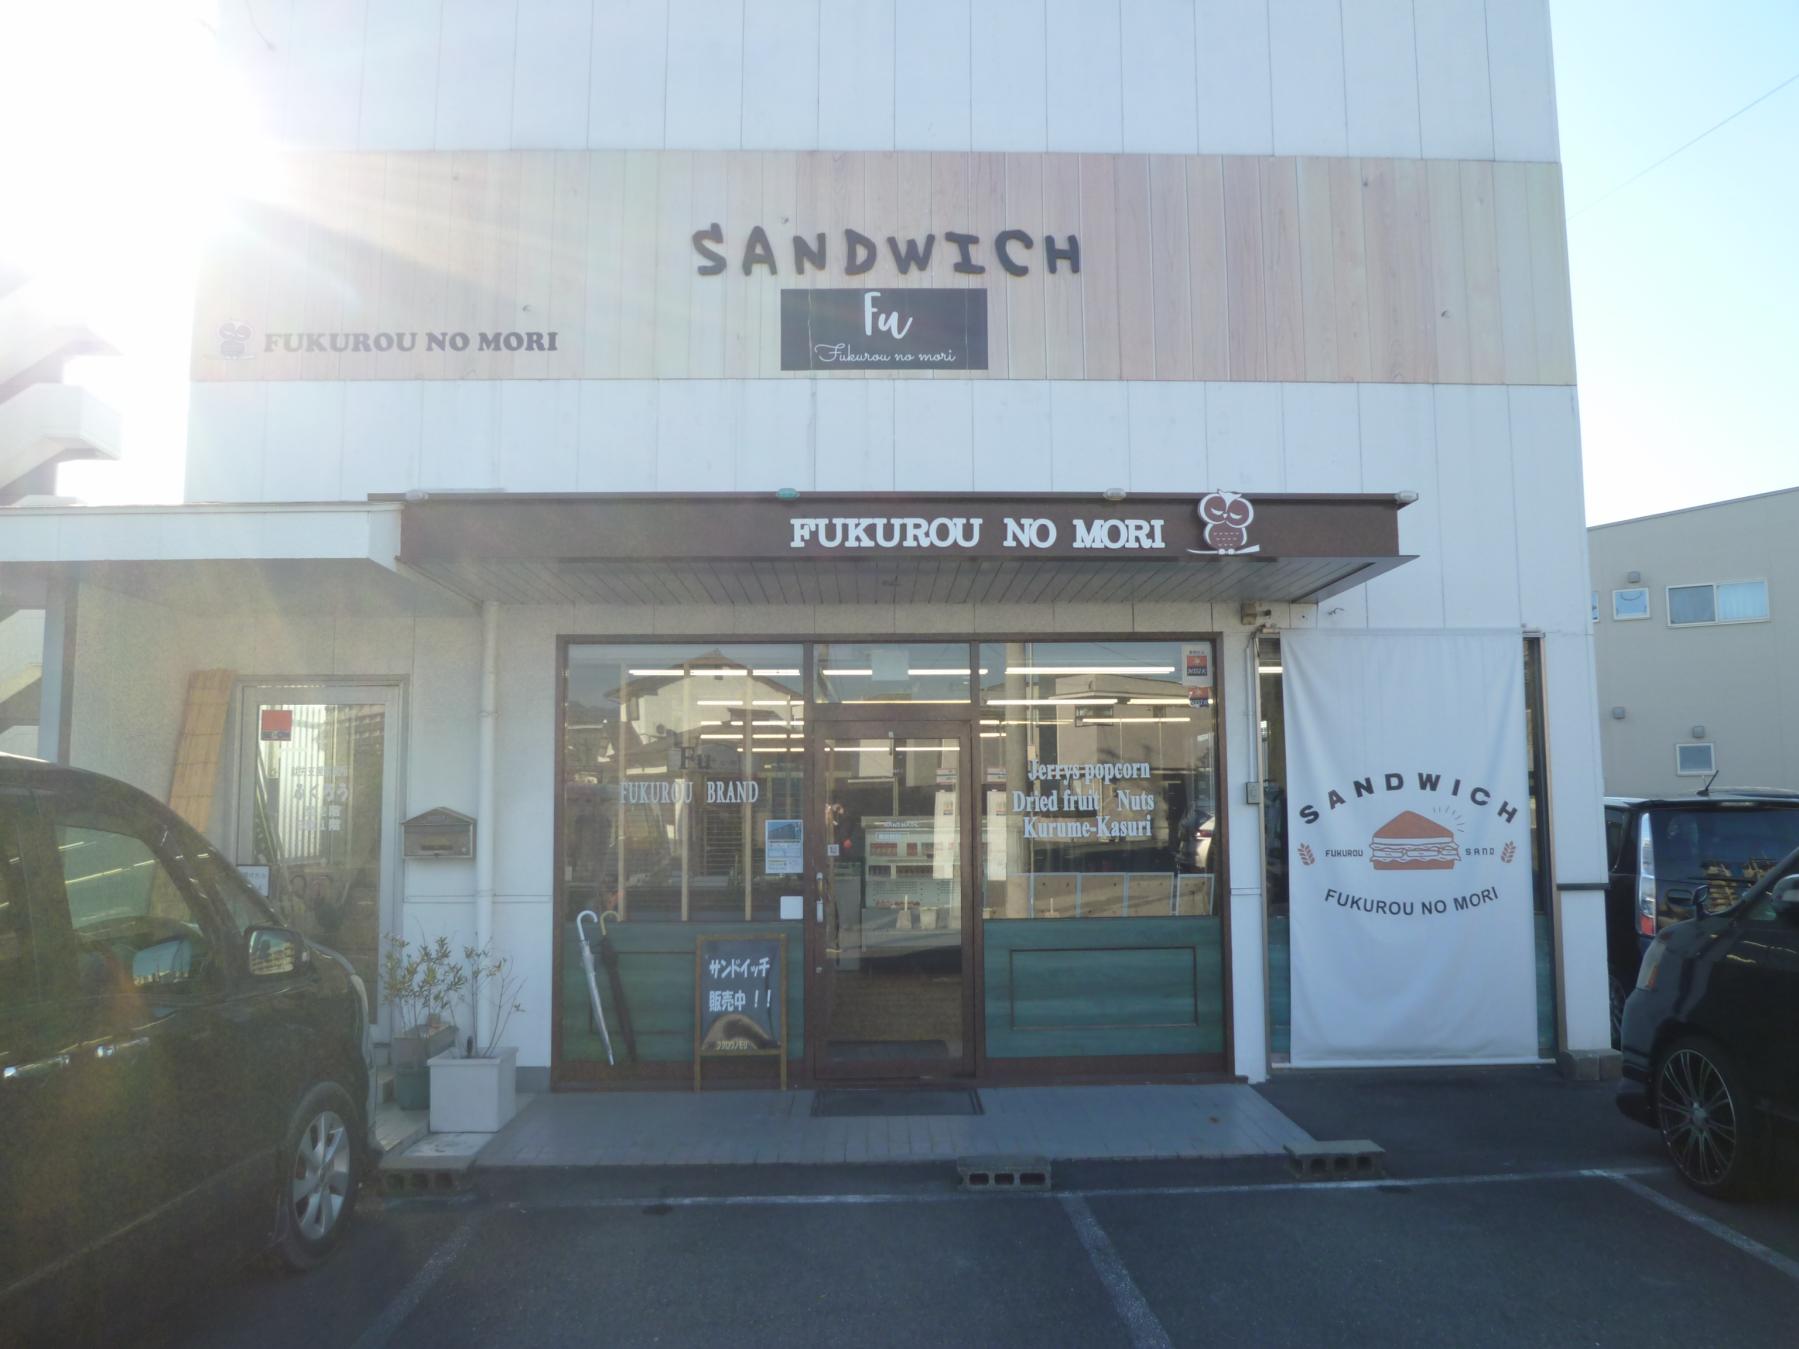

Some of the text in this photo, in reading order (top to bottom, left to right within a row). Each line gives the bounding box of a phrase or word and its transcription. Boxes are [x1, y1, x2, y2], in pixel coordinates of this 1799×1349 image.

[691, 222, 1081, 276] SANDWICH
[864, 291, 913, 340] Fu
[264, 332, 558, 352] FUKUROU NO MORI
[814, 342, 957, 363] Fukurou no mori
[789, 517, 1166, 550] FUKUROU NO MORI
[1027, 760, 1150, 784] Jerrys popcorn
[619, 780, 759, 803] FUKUROU BRAND
[1012, 790, 1154, 812] Dried fruit Nuts
[1299, 772, 1518, 825] SANDWICH
[1023, 815, 1153, 838] Kurume-Kasuri
[1325, 849, 1364, 857] FUKUROU
[1324, 885, 1499, 916] FUKUROU NO MORI
[709, 957, 770, 979] サンドイッチ
